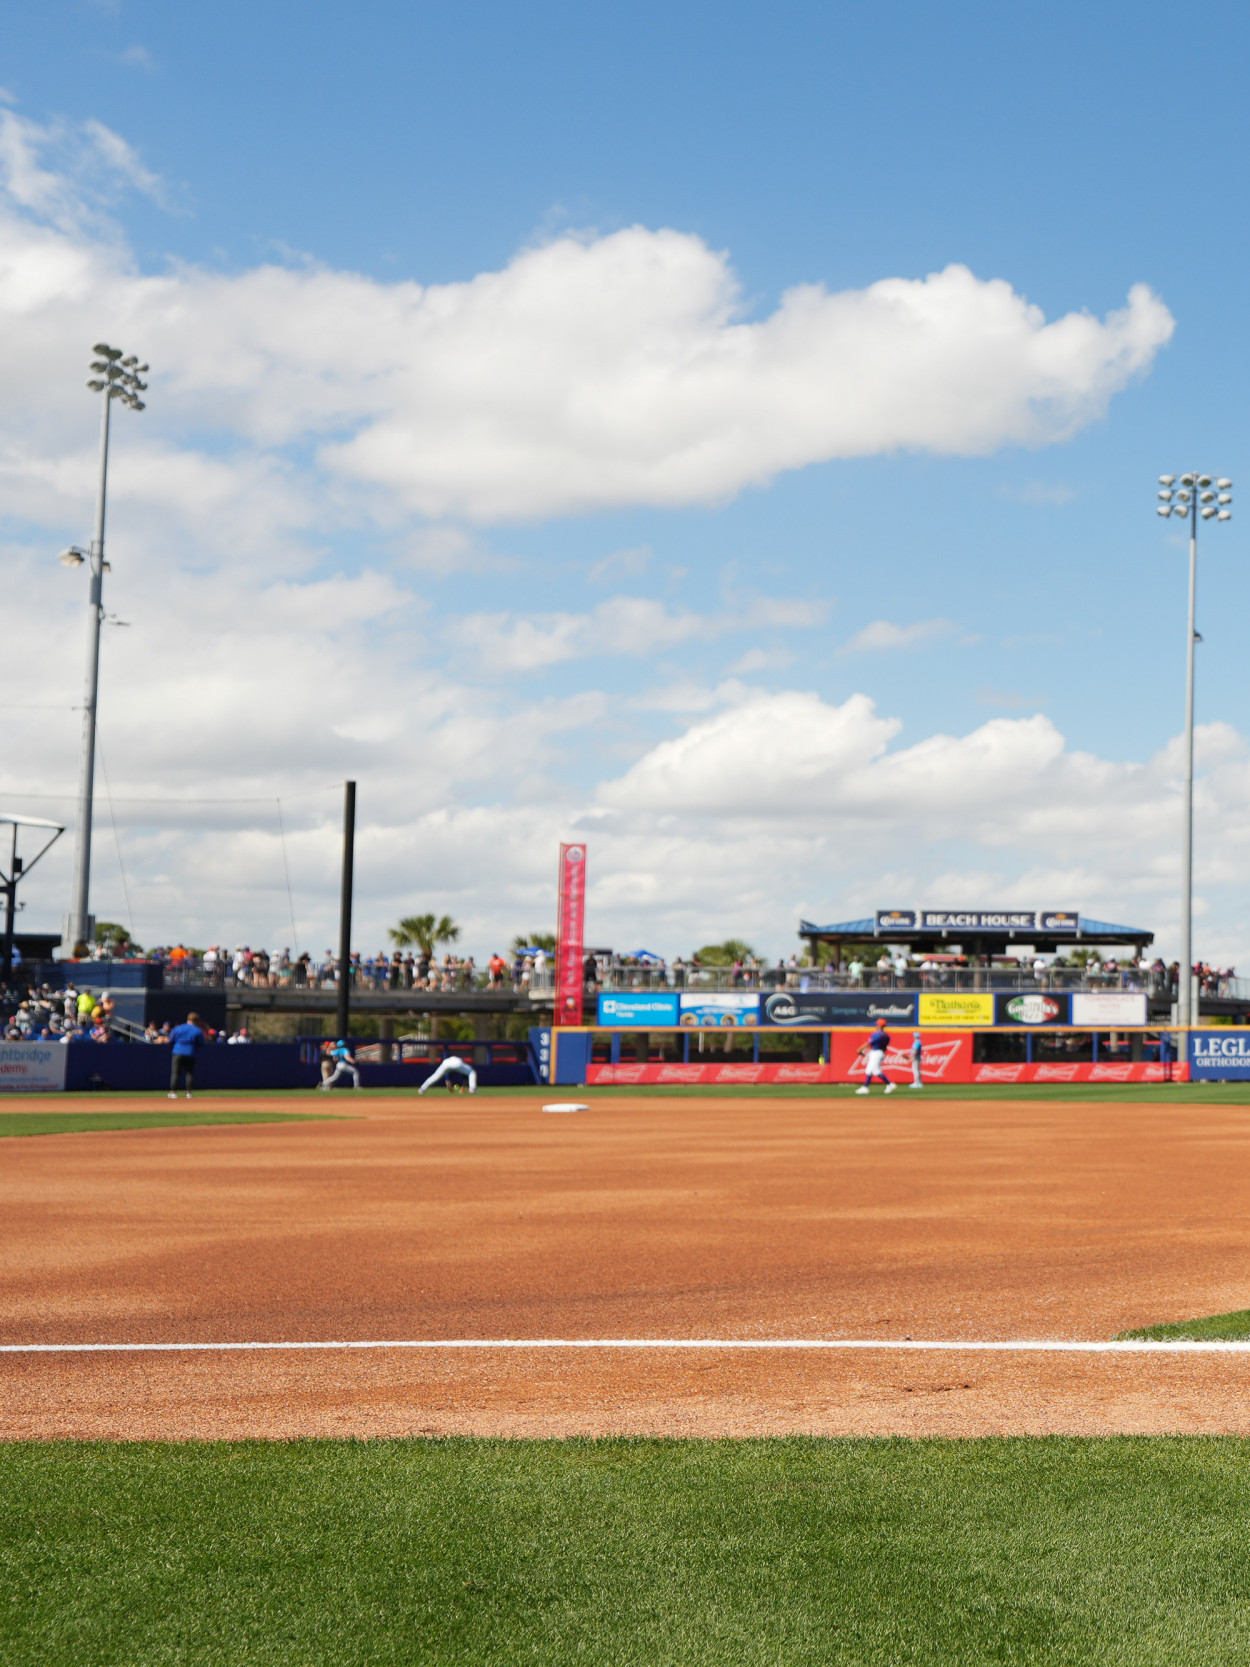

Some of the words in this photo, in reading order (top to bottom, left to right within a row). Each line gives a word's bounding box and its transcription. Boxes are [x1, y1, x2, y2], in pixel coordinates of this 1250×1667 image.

[926, 914, 977, 926] BEACH
[981, 915, 1030, 926] HOUSE
[0, 1049, 51, 1063] htbridge
